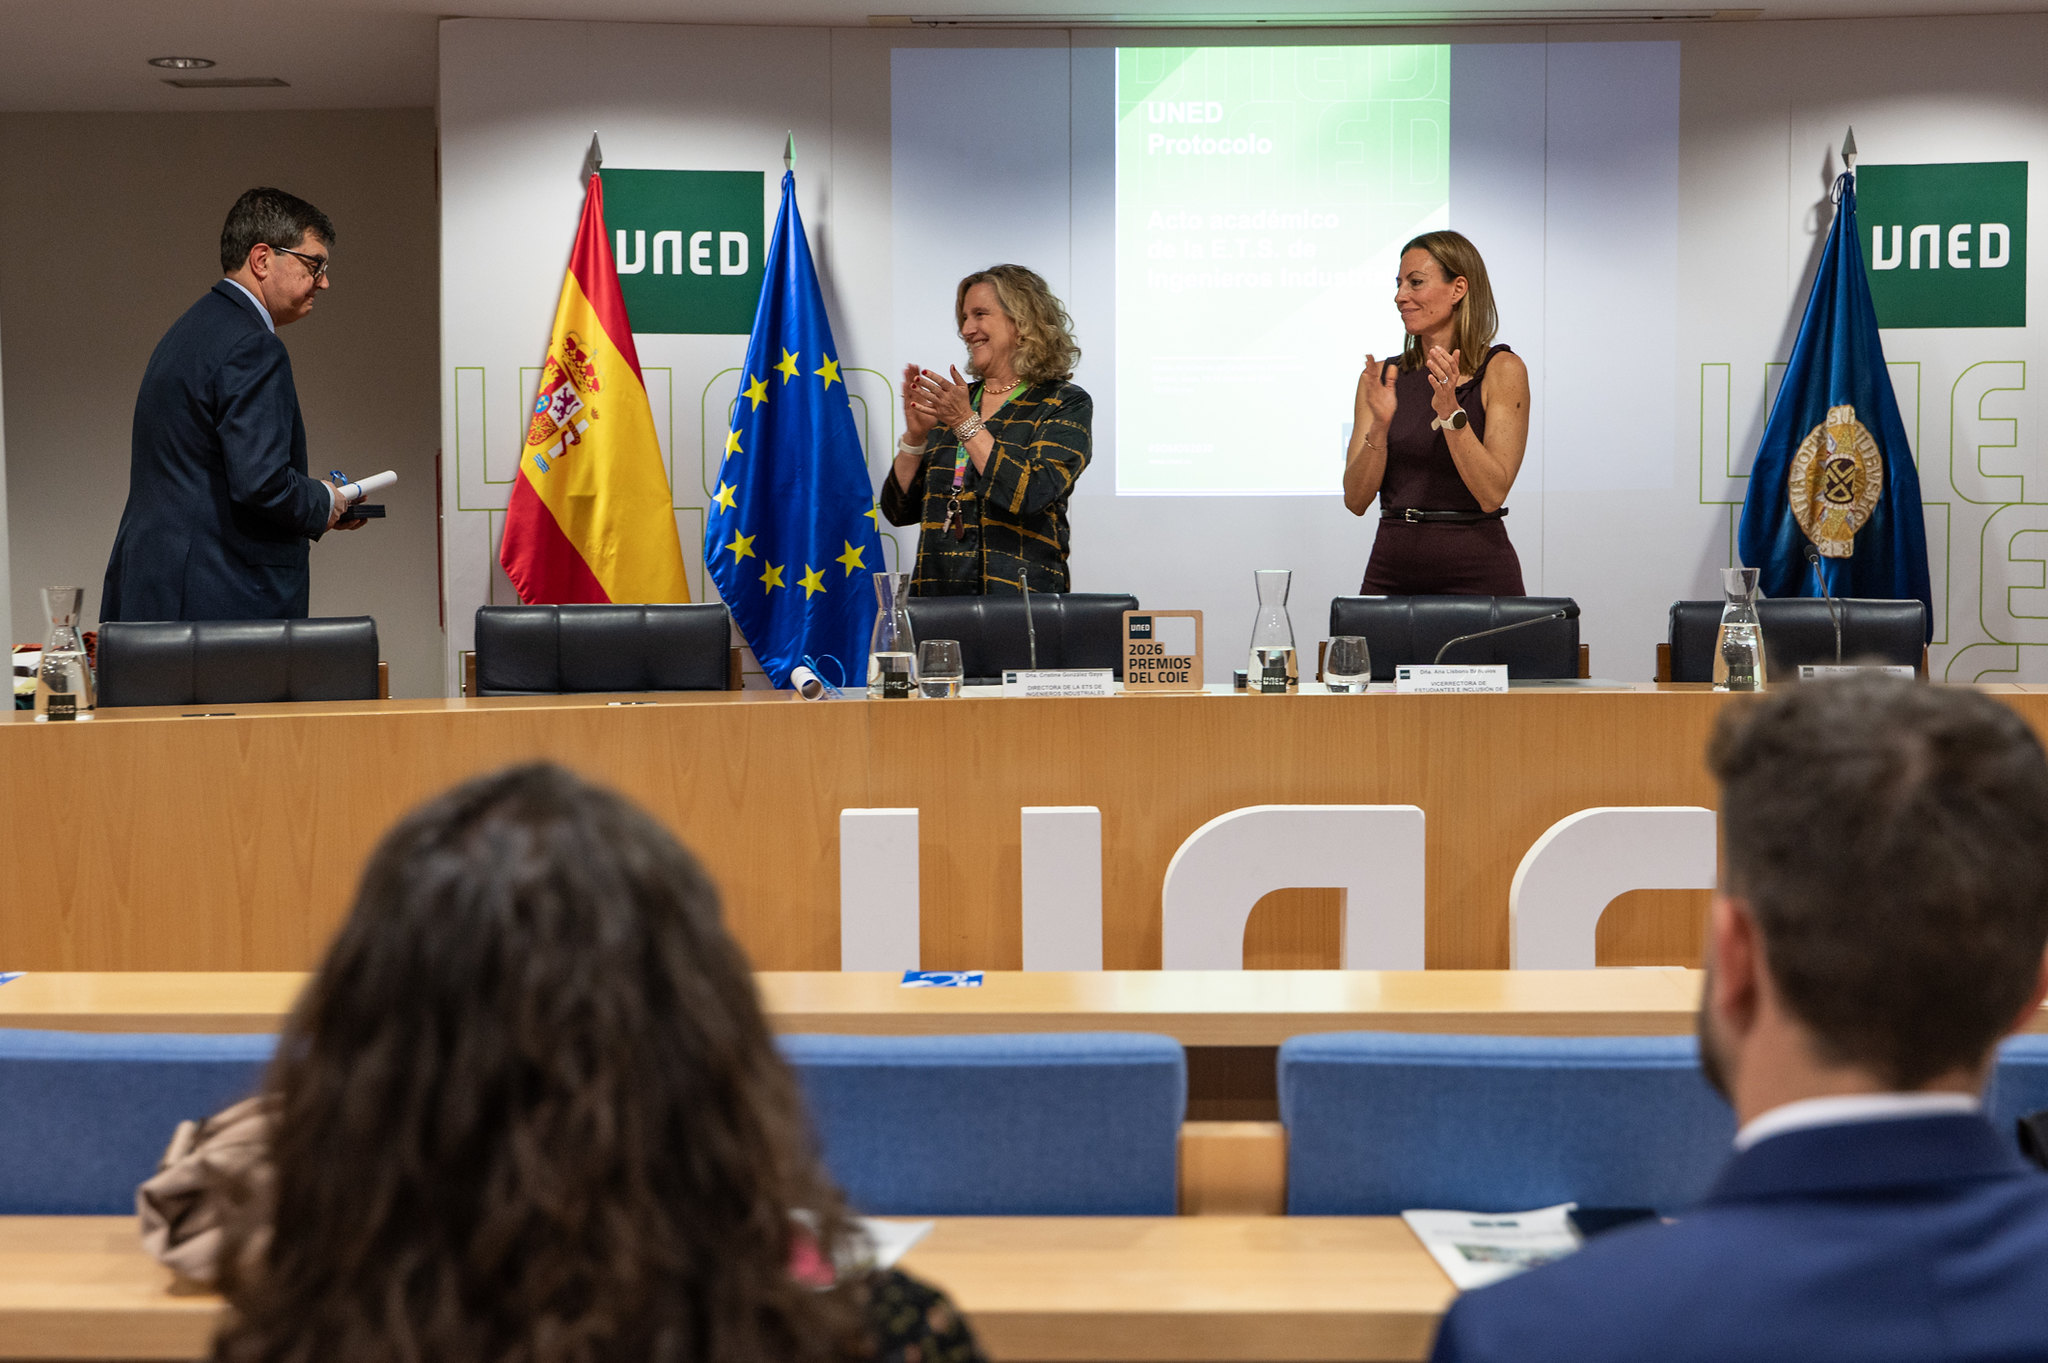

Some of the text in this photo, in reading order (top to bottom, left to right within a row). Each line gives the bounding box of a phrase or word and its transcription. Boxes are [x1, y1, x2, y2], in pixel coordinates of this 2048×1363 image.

[1147, 101, 1224, 124] UNED
[1147, 133, 1273, 156] Protocolo
[1146, 208, 1340, 232] Acto académico
[616, 229, 749, 275] UNED
[1147, 238, 1318, 260] de la E.T.S. de
[1872, 223, 2010, 270] UNED
[1148, 267, 1273, 294] Ingenieros
[1129, 644, 1163, 656] 2026
[1129, 658, 1192, 670] PREMIOS
[1129, 671, 1189, 683] DEL COIE
